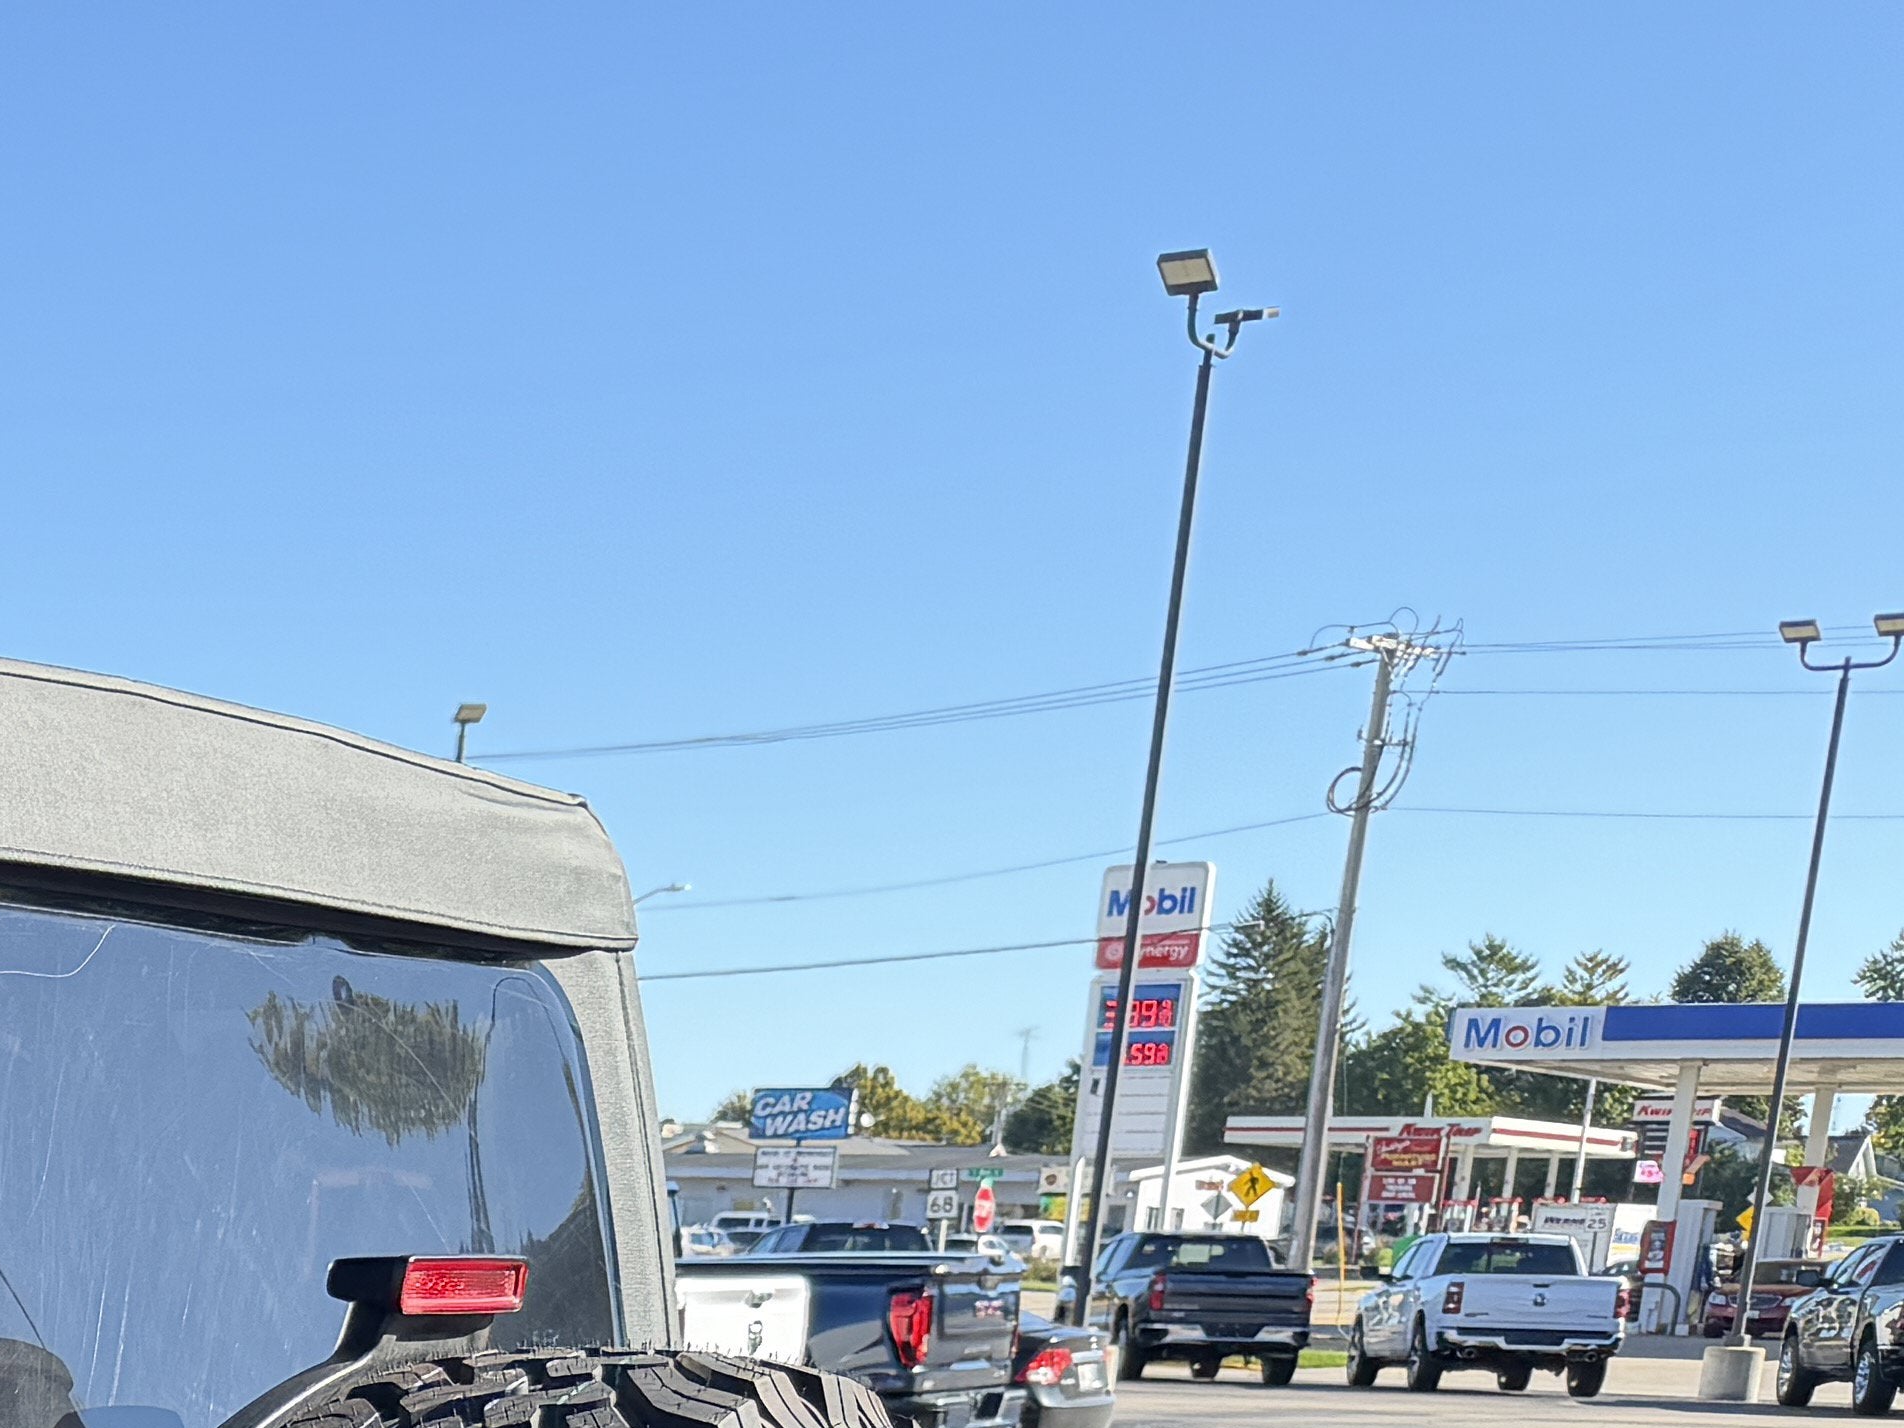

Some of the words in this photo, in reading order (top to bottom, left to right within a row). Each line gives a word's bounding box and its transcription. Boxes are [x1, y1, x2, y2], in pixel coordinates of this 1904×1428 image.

[1463, 1016, 1590, 1049] Mobil
[754, 1091, 812, 1117] CAR
[764, 1107, 846, 1136] WASH
[930, 1196, 954, 1214] 68
[1587, 1218, 1607, 1230] 25
